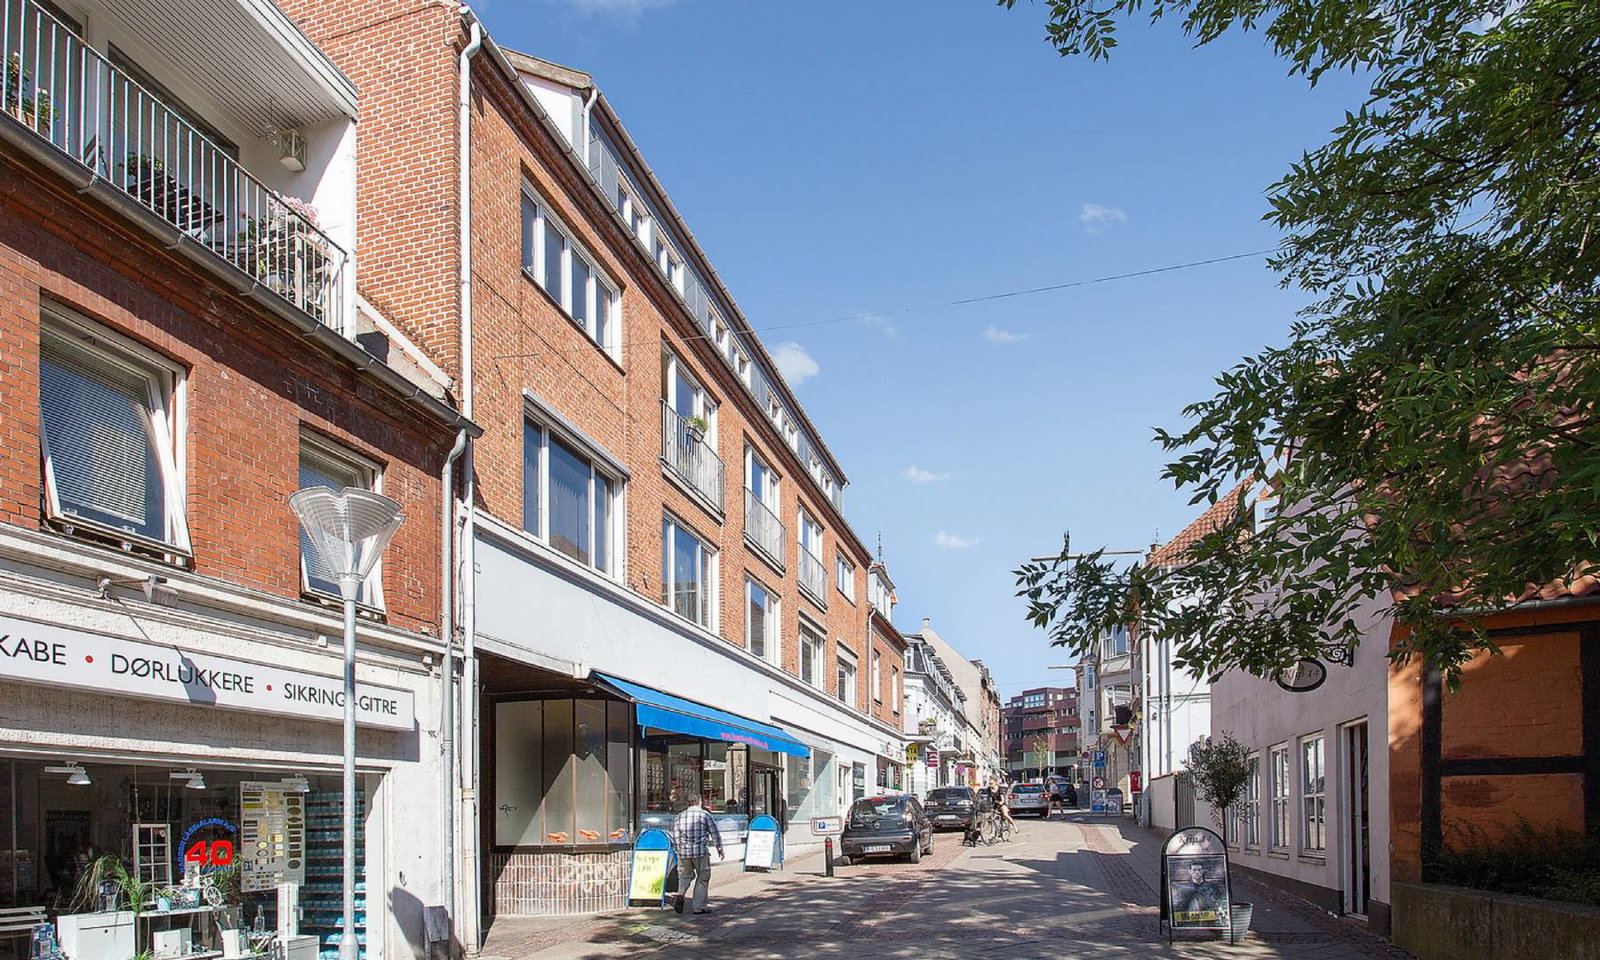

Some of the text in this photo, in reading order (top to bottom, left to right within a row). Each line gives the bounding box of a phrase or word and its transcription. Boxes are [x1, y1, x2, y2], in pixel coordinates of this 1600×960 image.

[111, 653, 254, 694] DØRLUKKERE
[284, 682, 398, 716] SIKRING-GITRE
[185, 841, 234, 867] 40
